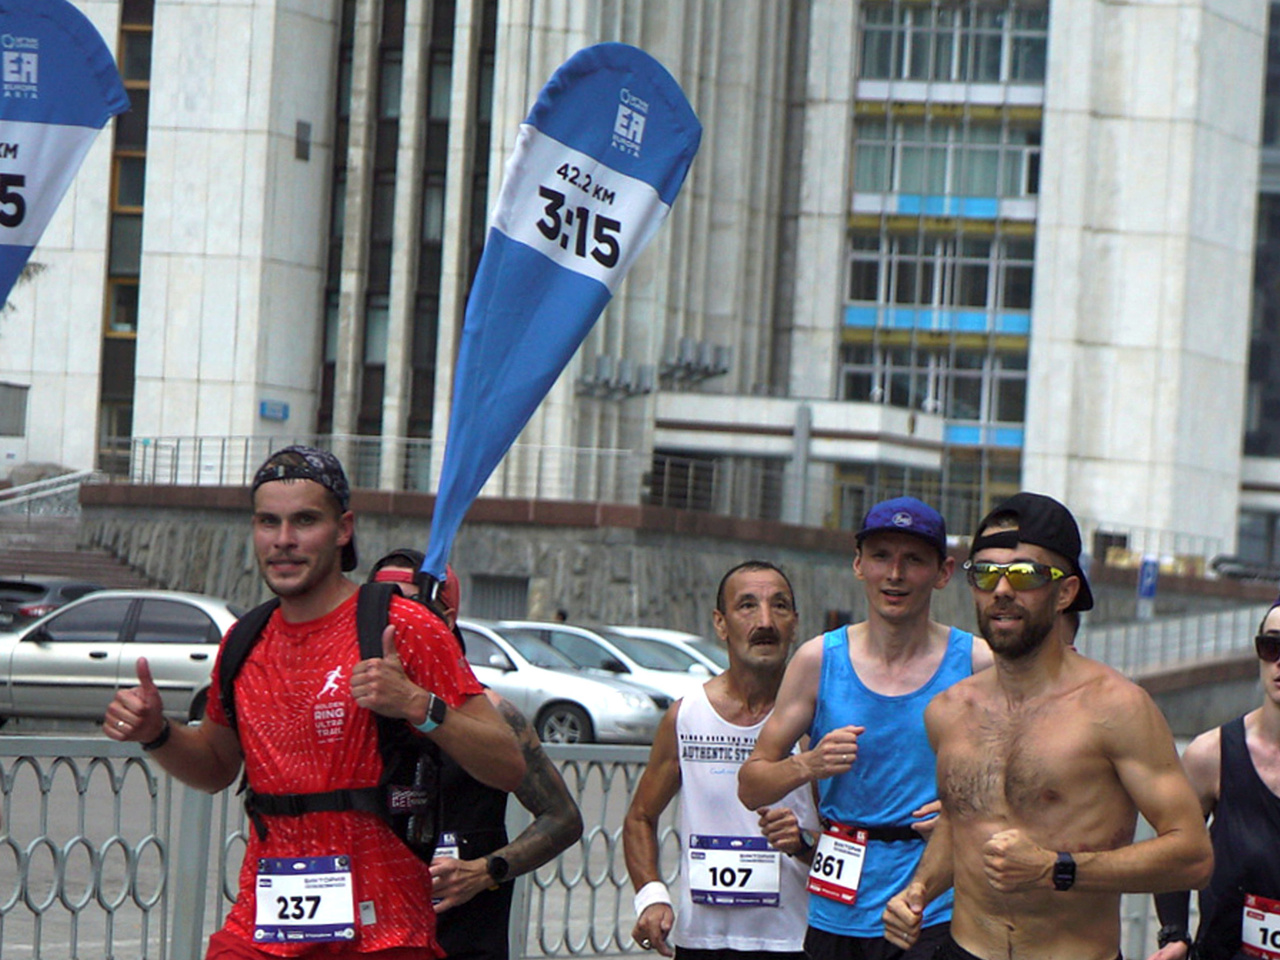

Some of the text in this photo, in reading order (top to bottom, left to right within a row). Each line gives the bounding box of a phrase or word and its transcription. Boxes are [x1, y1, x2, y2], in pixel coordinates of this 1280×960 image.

[556, 163, 616, 206] 42.2 KM
[536, 185, 621, 269] 3:15
[314, 708, 345, 720] RING
[315, 719, 344, 729] ULTRA
[317, 727, 344, 737] TRAIL
[682, 746, 733, 760] AUTHENTIC
[708, 867, 753, 887] 107
[276, 896, 321, 920] 237
